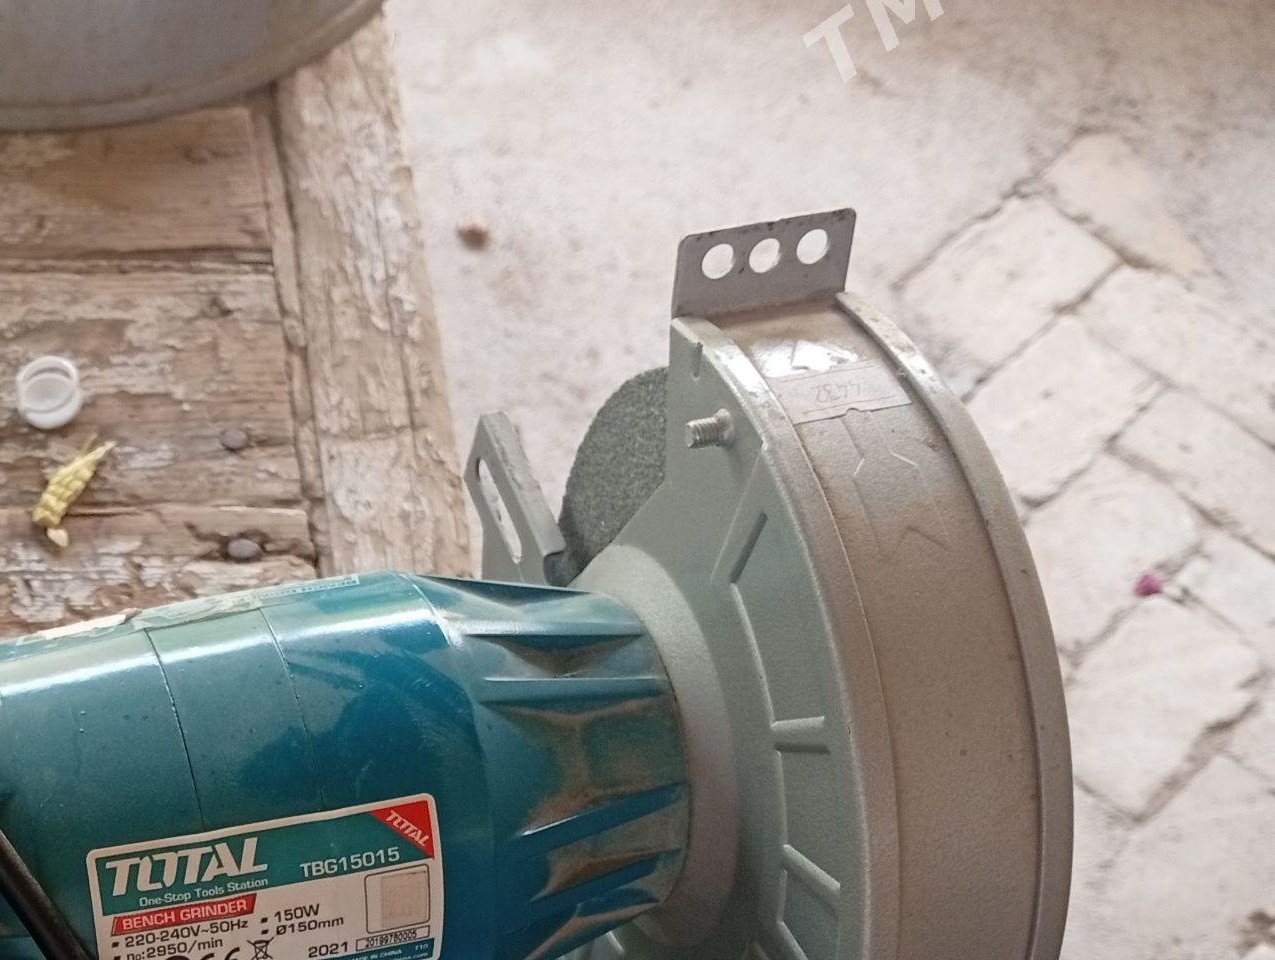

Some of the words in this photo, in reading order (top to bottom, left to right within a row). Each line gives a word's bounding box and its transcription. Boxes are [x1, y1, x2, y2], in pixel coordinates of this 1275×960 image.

[385, 810, 429, 847] TOTAL
[105, 836, 268, 897] TOTAL
[300, 847, 400, 878] TBG15015
[139, 891, 192, 908] One-Stop
[194, 885, 225, 898] Tools
[227, 878, 269, 893] Station
[122, 912, 176, 931] BENCH
[180, 899, 247, 921] GRINDER
[274, 903, 320, 923] 150W
[276, 916, 344, 935] Ø150mm
[308, 941, 349, 959] 2021
[380, 949, 402, 958] CHINA
